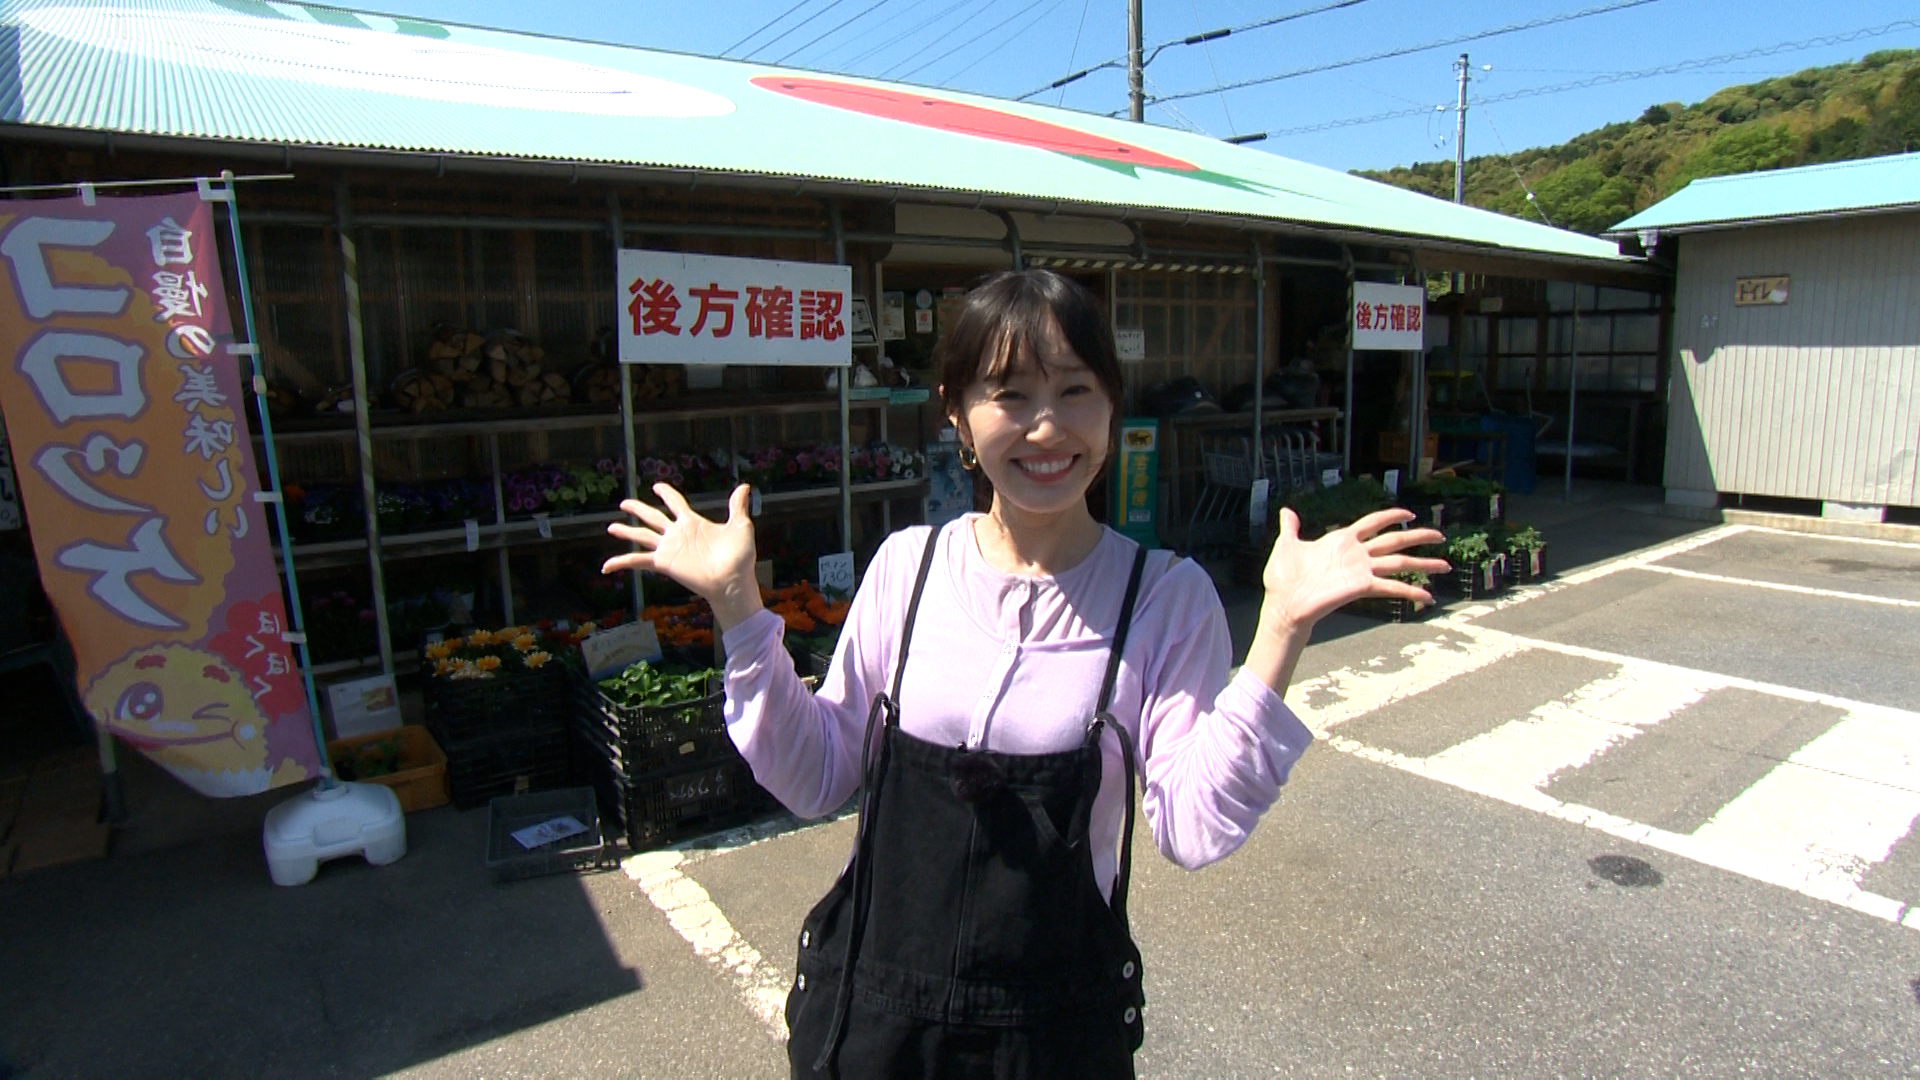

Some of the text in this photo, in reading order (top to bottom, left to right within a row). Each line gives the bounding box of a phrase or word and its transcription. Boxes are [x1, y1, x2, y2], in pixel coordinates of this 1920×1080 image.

[628, 277, 845, 341] 後方確認
[1356, 301, 1421, 331] 後方確認
